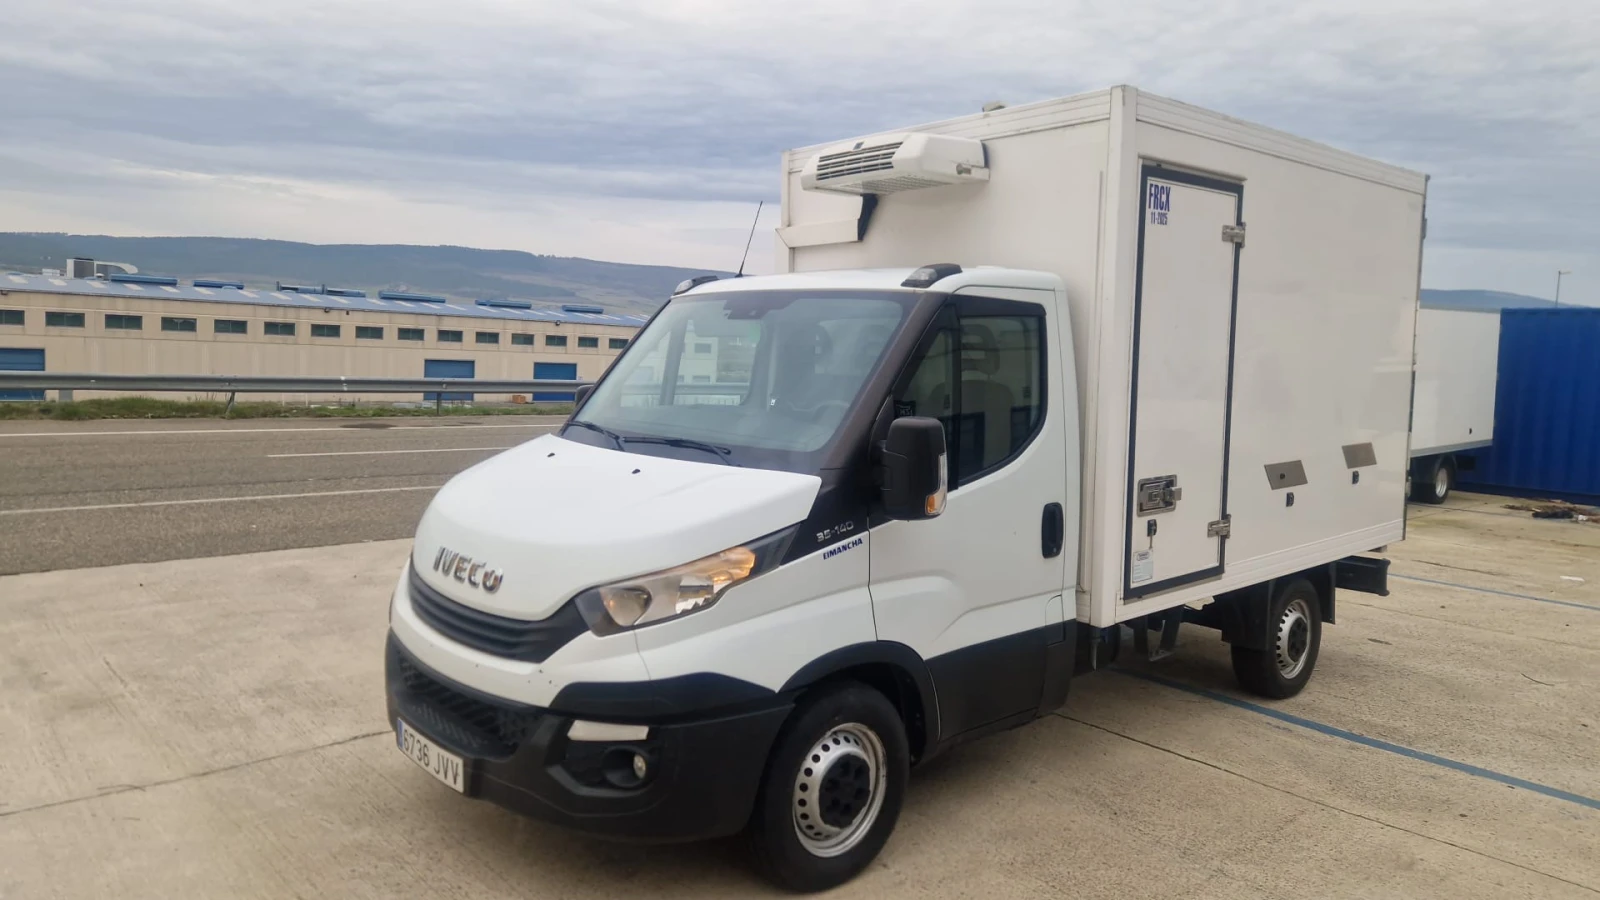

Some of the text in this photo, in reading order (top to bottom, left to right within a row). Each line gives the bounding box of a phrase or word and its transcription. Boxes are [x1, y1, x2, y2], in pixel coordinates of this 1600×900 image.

[1148, 183, 1171, 212] FRCX
[816, 521, 854, 542] 35-140
[433, 546, 504, 594] IVECO
[403, 729, 459, 786] 6736 JVV
